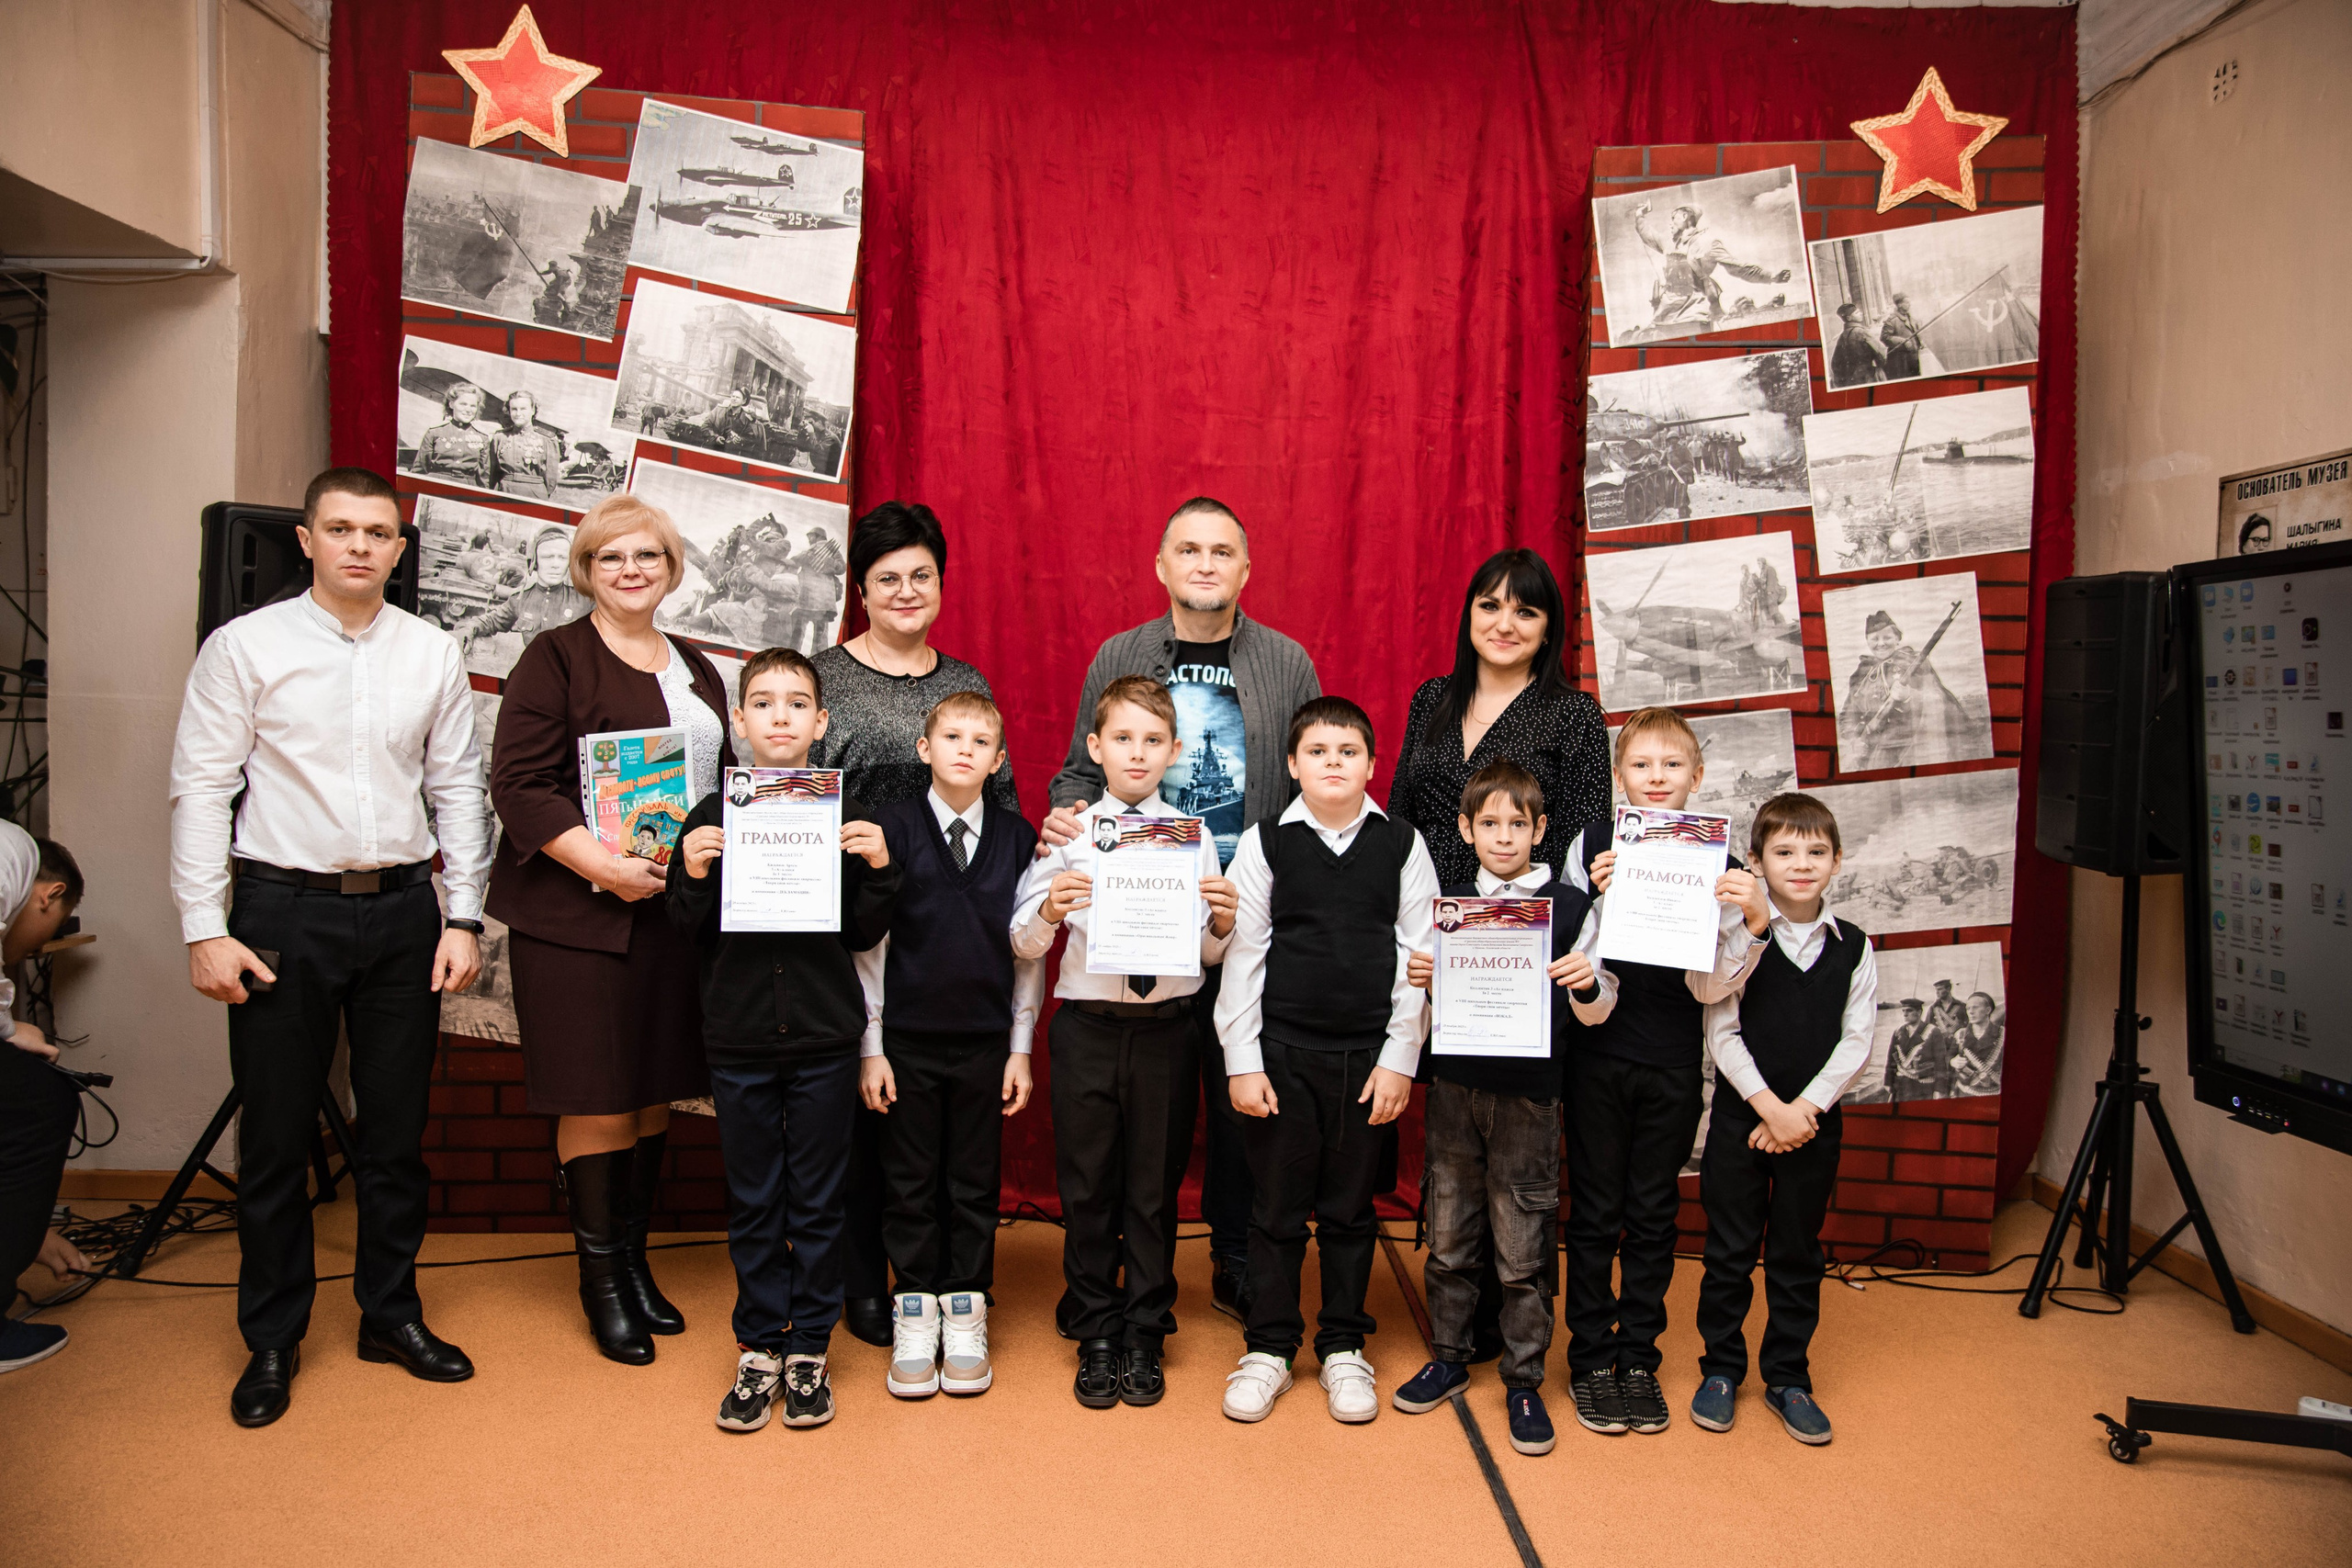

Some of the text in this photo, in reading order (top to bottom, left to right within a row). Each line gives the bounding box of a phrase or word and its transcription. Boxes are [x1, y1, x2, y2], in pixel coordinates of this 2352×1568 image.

[787, 212, 802, 226] 25
[2237, 460, 2348, 501] ОСНОВАТЕЛЬ МУЗЕЯ
[2286, 518, 2342, 538] ШАЛЫГИНА
[741, 831, 825, 845] ГРАМОТА
[1106, 876, 1185, 891] ГРАМОТА
[1627, 867, 1705, 887] ГРАМОТА
[1449, 956, 1533, 969] ГРАМОТА
